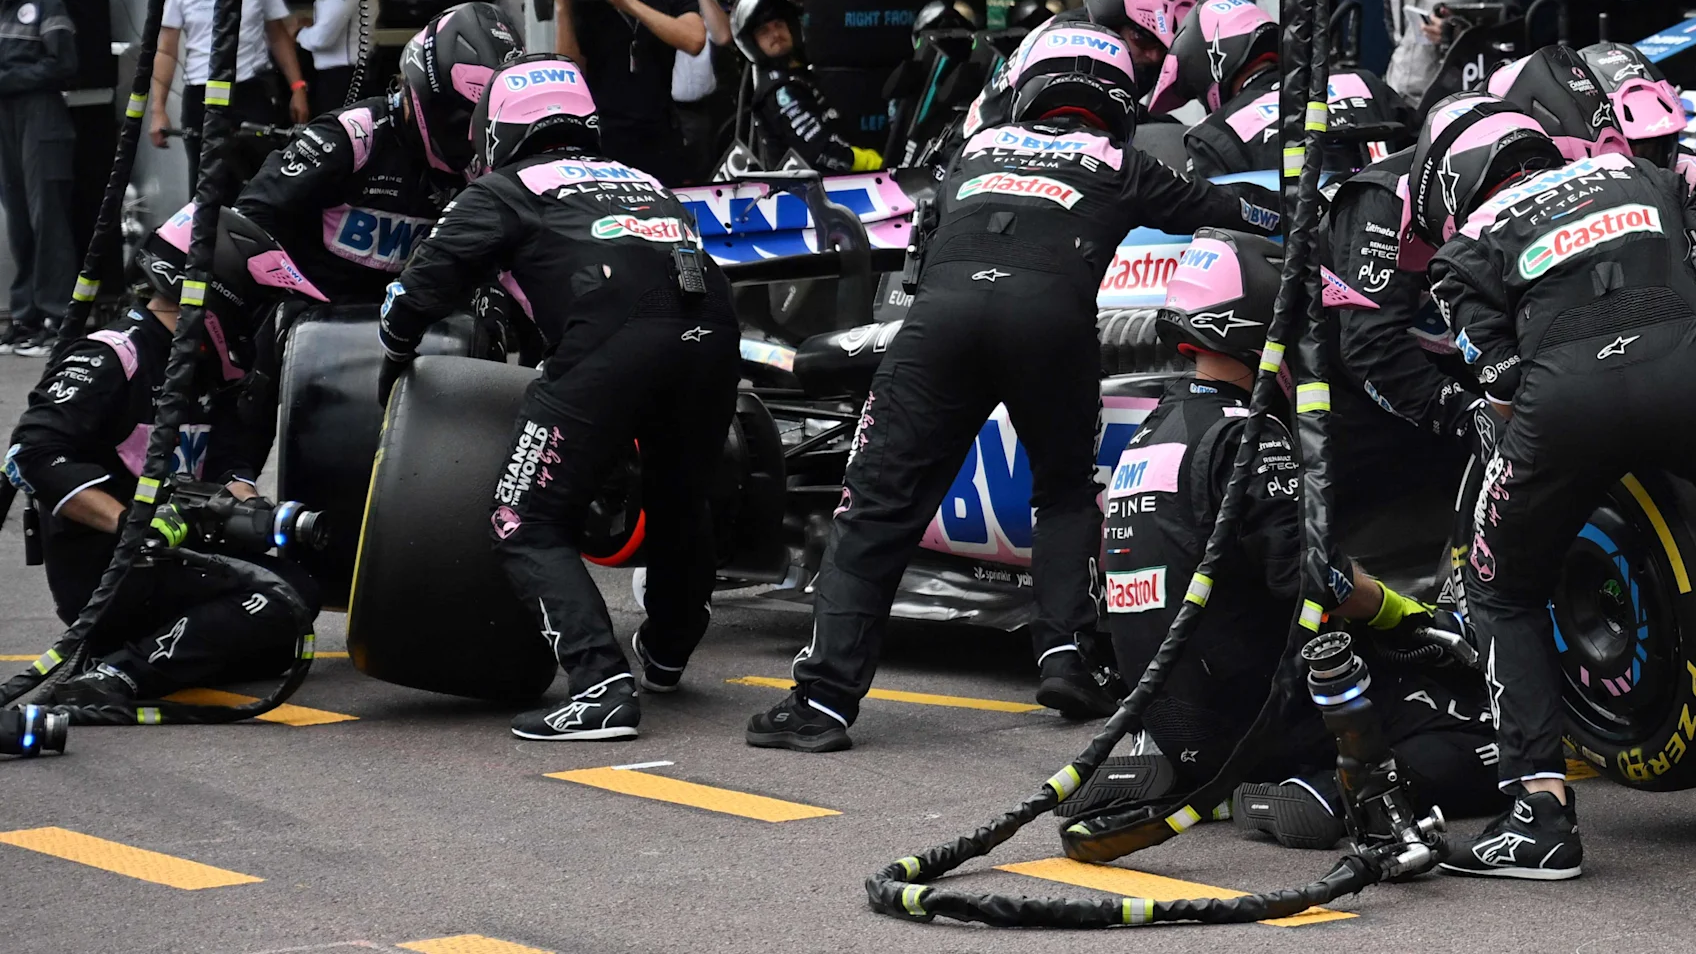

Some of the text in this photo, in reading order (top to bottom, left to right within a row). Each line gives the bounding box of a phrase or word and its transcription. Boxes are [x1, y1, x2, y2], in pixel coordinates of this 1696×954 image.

[844, 10, 917, 28] RIGHT FRON
[1070, 34, 1121, 57] BWT
[526, 68, 578, 85] BWT
[860, 115, 886, 131] LEF
[1020, 158, 1058, 169] TEAM
[369, 174, 403, 184] LPINE
[982, 174, 1075, 204] Castrol
[1416, 157, 1434, 217] shamir
[619, 194, 655, 204] TEAM
[1489, 171, 1632, 233] ALPINE
[1556, 185, 1605, 208] TEAM
[1554, 208, 1657, 257] Castrol
[1100, 251, 1181, 291] Castro
[1180, 249, 1220, 272] BWT
[1358, 260, 1393, 293] plug
[1495, 354, 1522, 374] Ross
[47, 379, 79, 404] plug
[500, 419, 538, 504] CHANGE
[518, 426, 549, 492] WORLD
[1262, 454, 1292, 464] RENAULT
[1112, 460, 1149, 491] BWT
[1107, 496, 1157, 519] PINE
[1110, 525, 1135, 540] TEAM
[1108, 573, 1160, 609] Castrol
